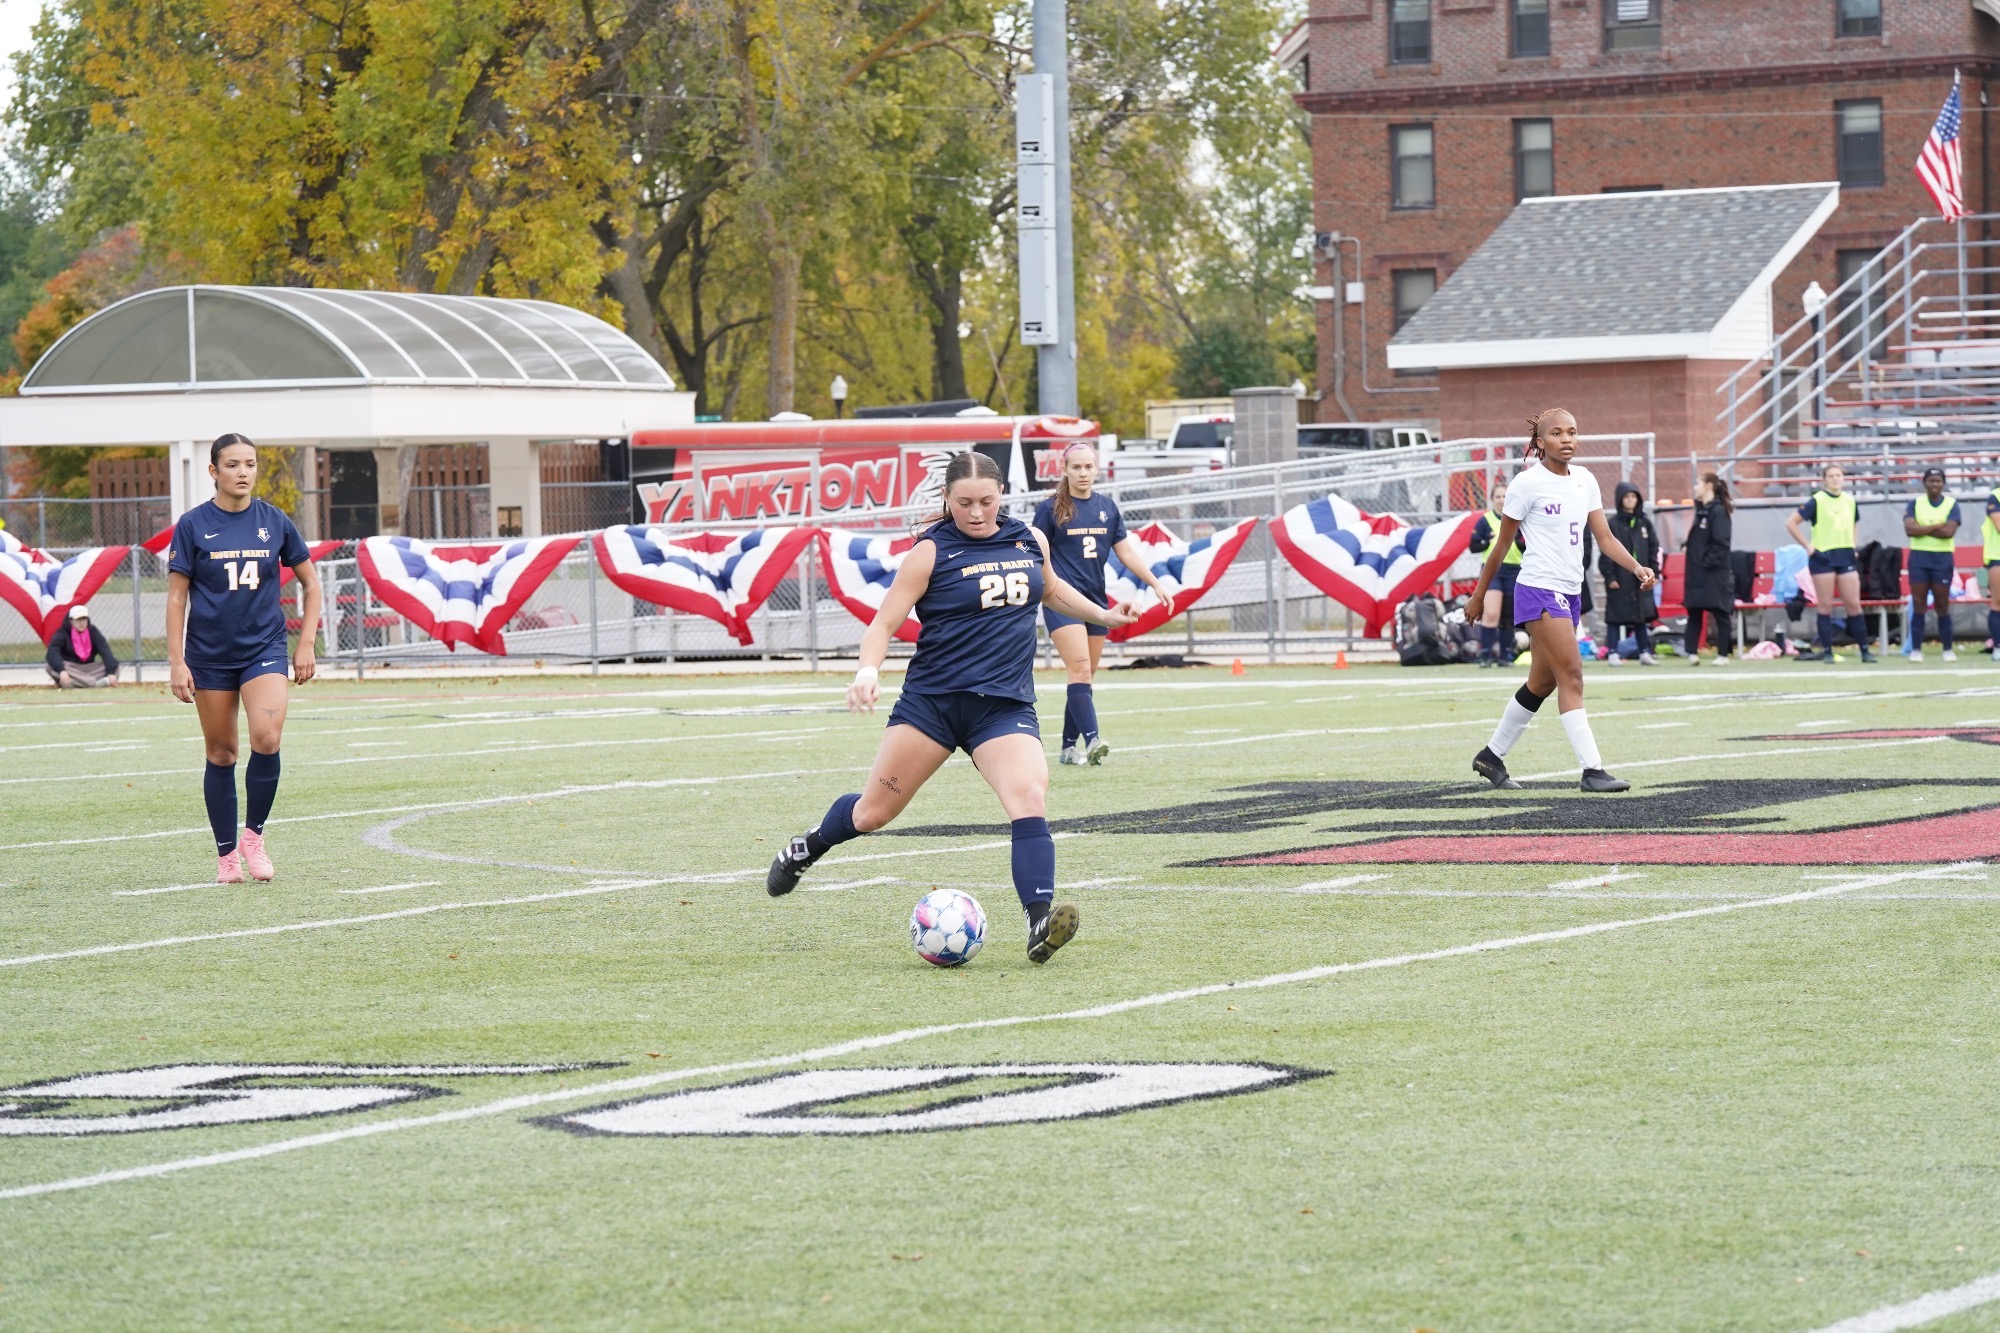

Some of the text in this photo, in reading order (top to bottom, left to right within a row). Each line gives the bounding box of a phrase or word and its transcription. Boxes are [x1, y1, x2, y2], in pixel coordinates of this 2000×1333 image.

[637, 457, 899, 524] YANKTON
[1569, 521, 1579, 546] 5
[210, 551, 240, 559] MOUNT
[1082, 535, 1098, 559] 2
[223, 560, 260, 591] 14
[961, 559, 1034, 577] MOUNT MARTY
[979, 571, 1030, 610] 26
